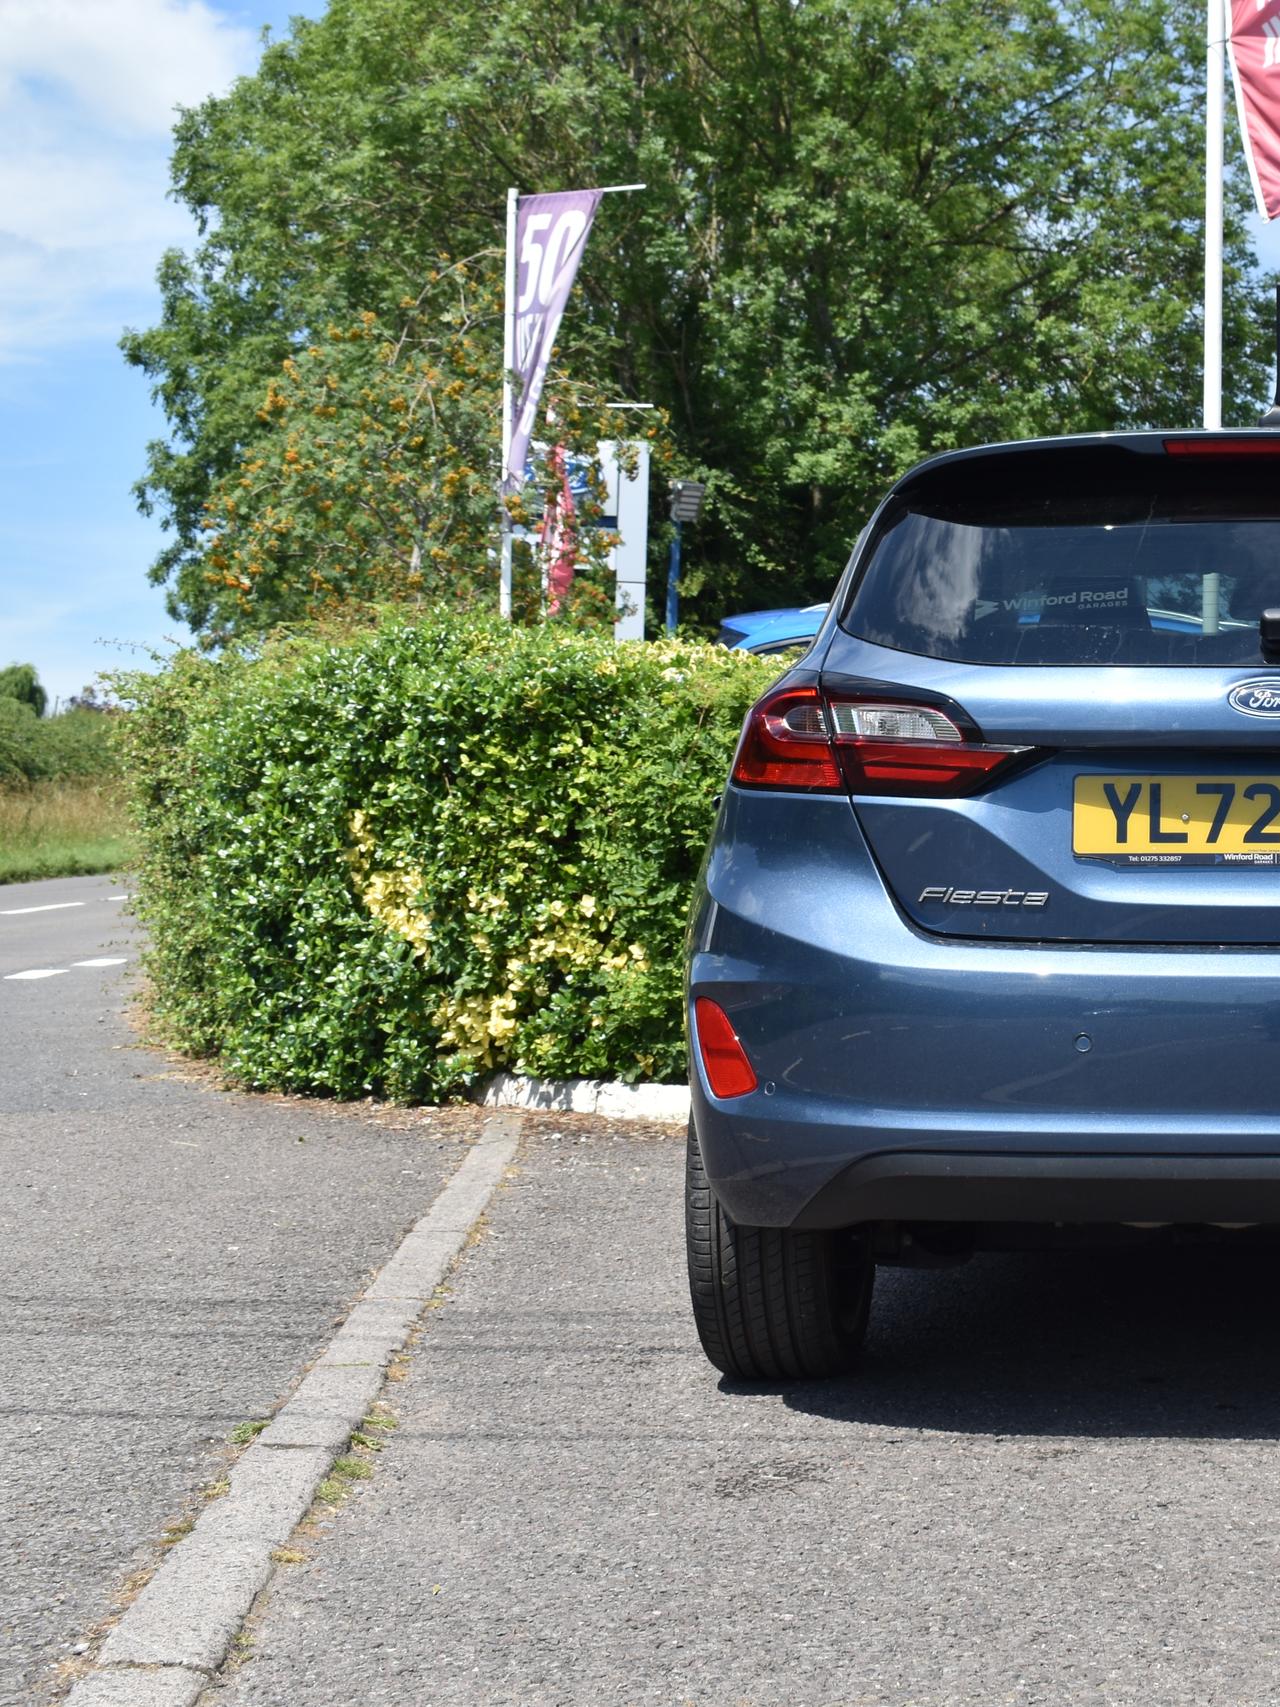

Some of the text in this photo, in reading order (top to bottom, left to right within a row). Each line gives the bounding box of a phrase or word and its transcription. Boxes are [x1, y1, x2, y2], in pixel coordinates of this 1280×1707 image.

[518, 210, 587, 313] 50
[1003, 588, 1129, 611] Winford Road
[1078, 600, 1129, 610] GARAGES
[1223, 853, 1254, 861] Winford
[1254, 853, 1274, 861] Road
[918, 887, 1049, 906] Fiesta
